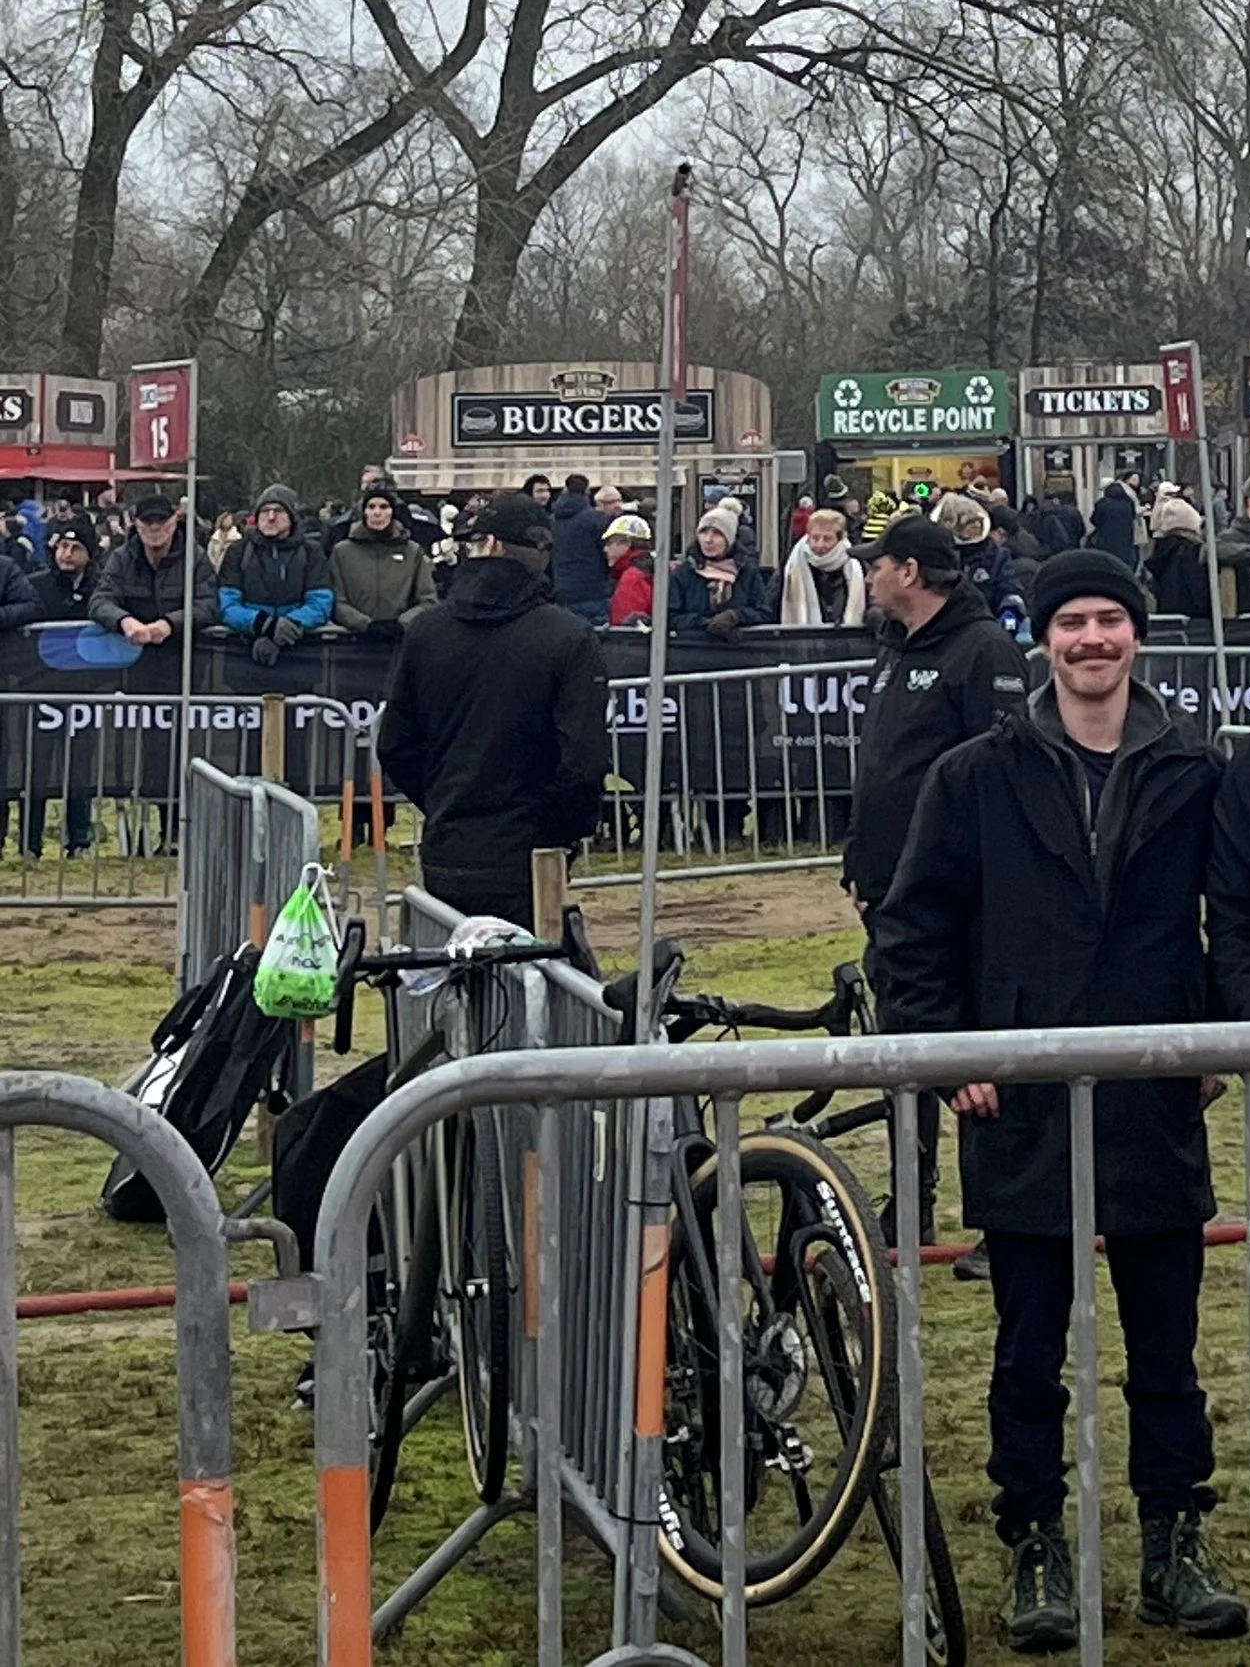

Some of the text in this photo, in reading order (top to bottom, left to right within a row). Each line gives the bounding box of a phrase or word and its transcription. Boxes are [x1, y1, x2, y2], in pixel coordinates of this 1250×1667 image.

[1037, 388, 1150, 414] TICKETS
[501, 404, 662, 434] BURGERS
[833, 406, 996, 434] RECYCLE POINT
[151, 417, 169, 459] 15
[778, 674, 870, 714] luc
[188, 705, 262, 729] naa
